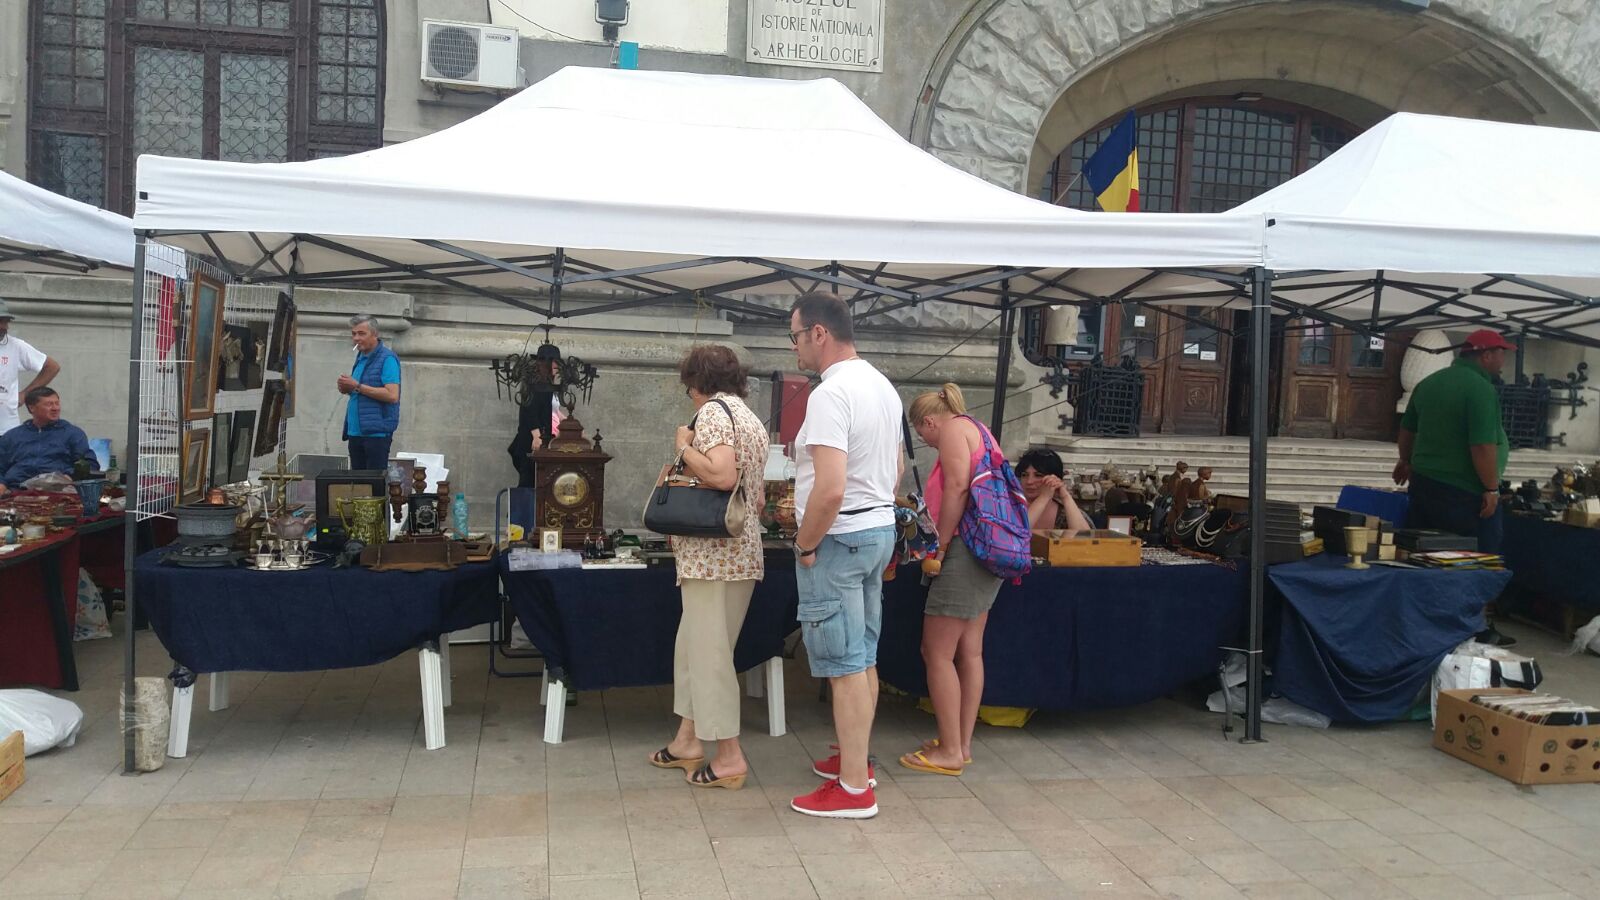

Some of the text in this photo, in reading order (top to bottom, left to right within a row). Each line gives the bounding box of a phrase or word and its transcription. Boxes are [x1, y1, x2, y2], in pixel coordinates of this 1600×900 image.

[811, 8, 822, 16] DE
[761, 14, 807, 32] ISTORIE
[767, 42, 866, 64] ARHEOLOGIE
